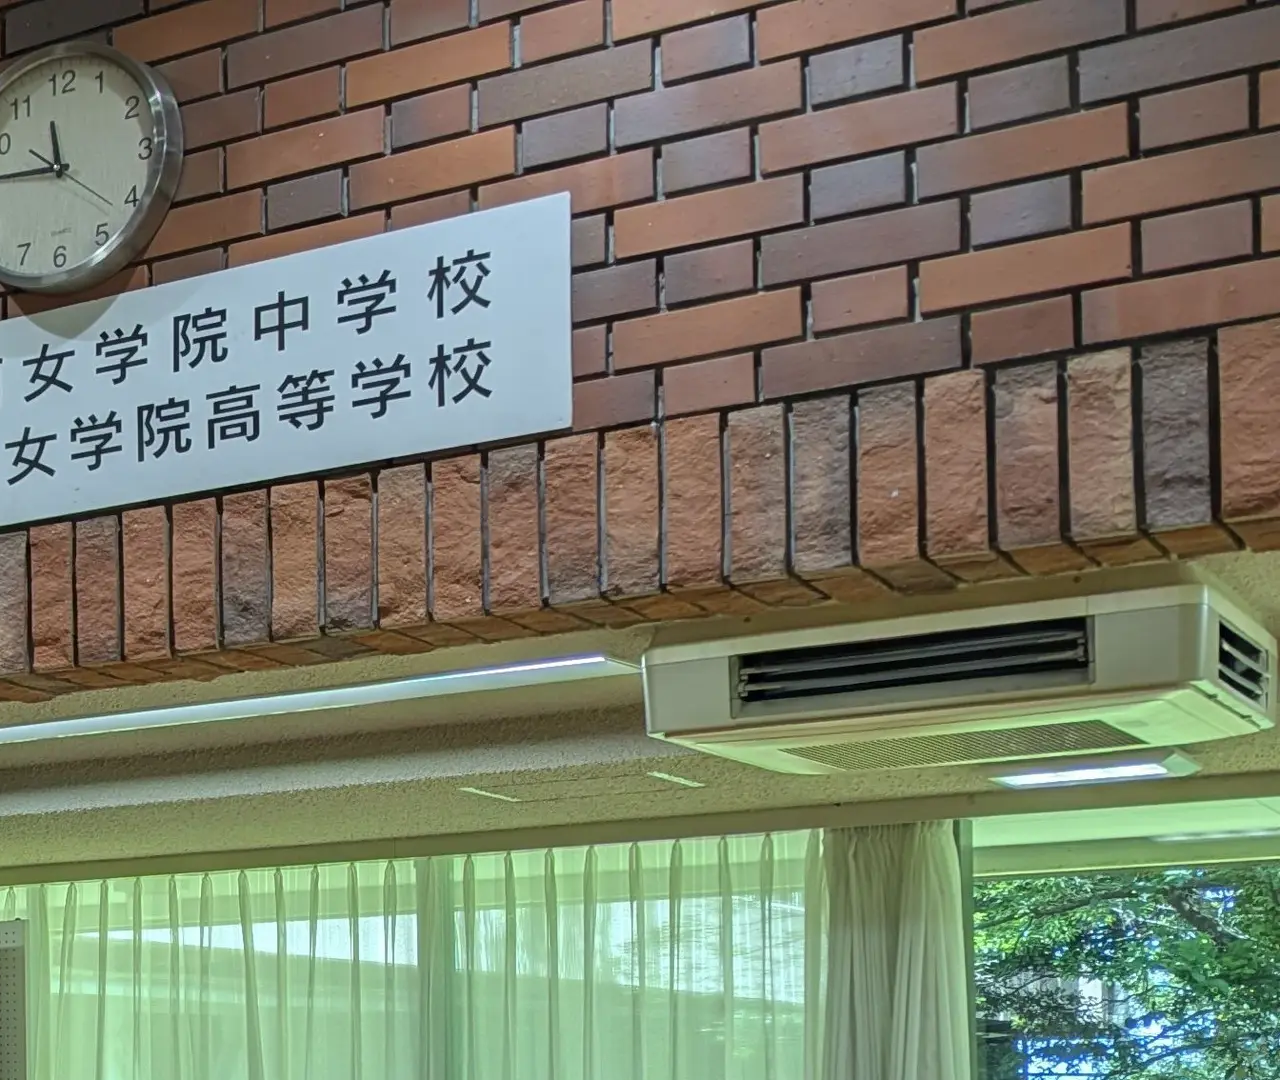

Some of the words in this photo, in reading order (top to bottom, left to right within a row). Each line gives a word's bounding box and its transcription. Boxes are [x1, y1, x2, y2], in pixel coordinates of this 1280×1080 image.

[48, 70, 76, 96] 12
[94, 71, 104, 94] 1
[10, 95, 31, 120] 11
[124, 95, 140, 120] 2
[138, 137, 153, 160] 3
[124, 185, 140, 207] 4
[95, 223, 109, 246] 5
[17, 242, 31, 266] 7
[53, 245, 68, 268] 6
